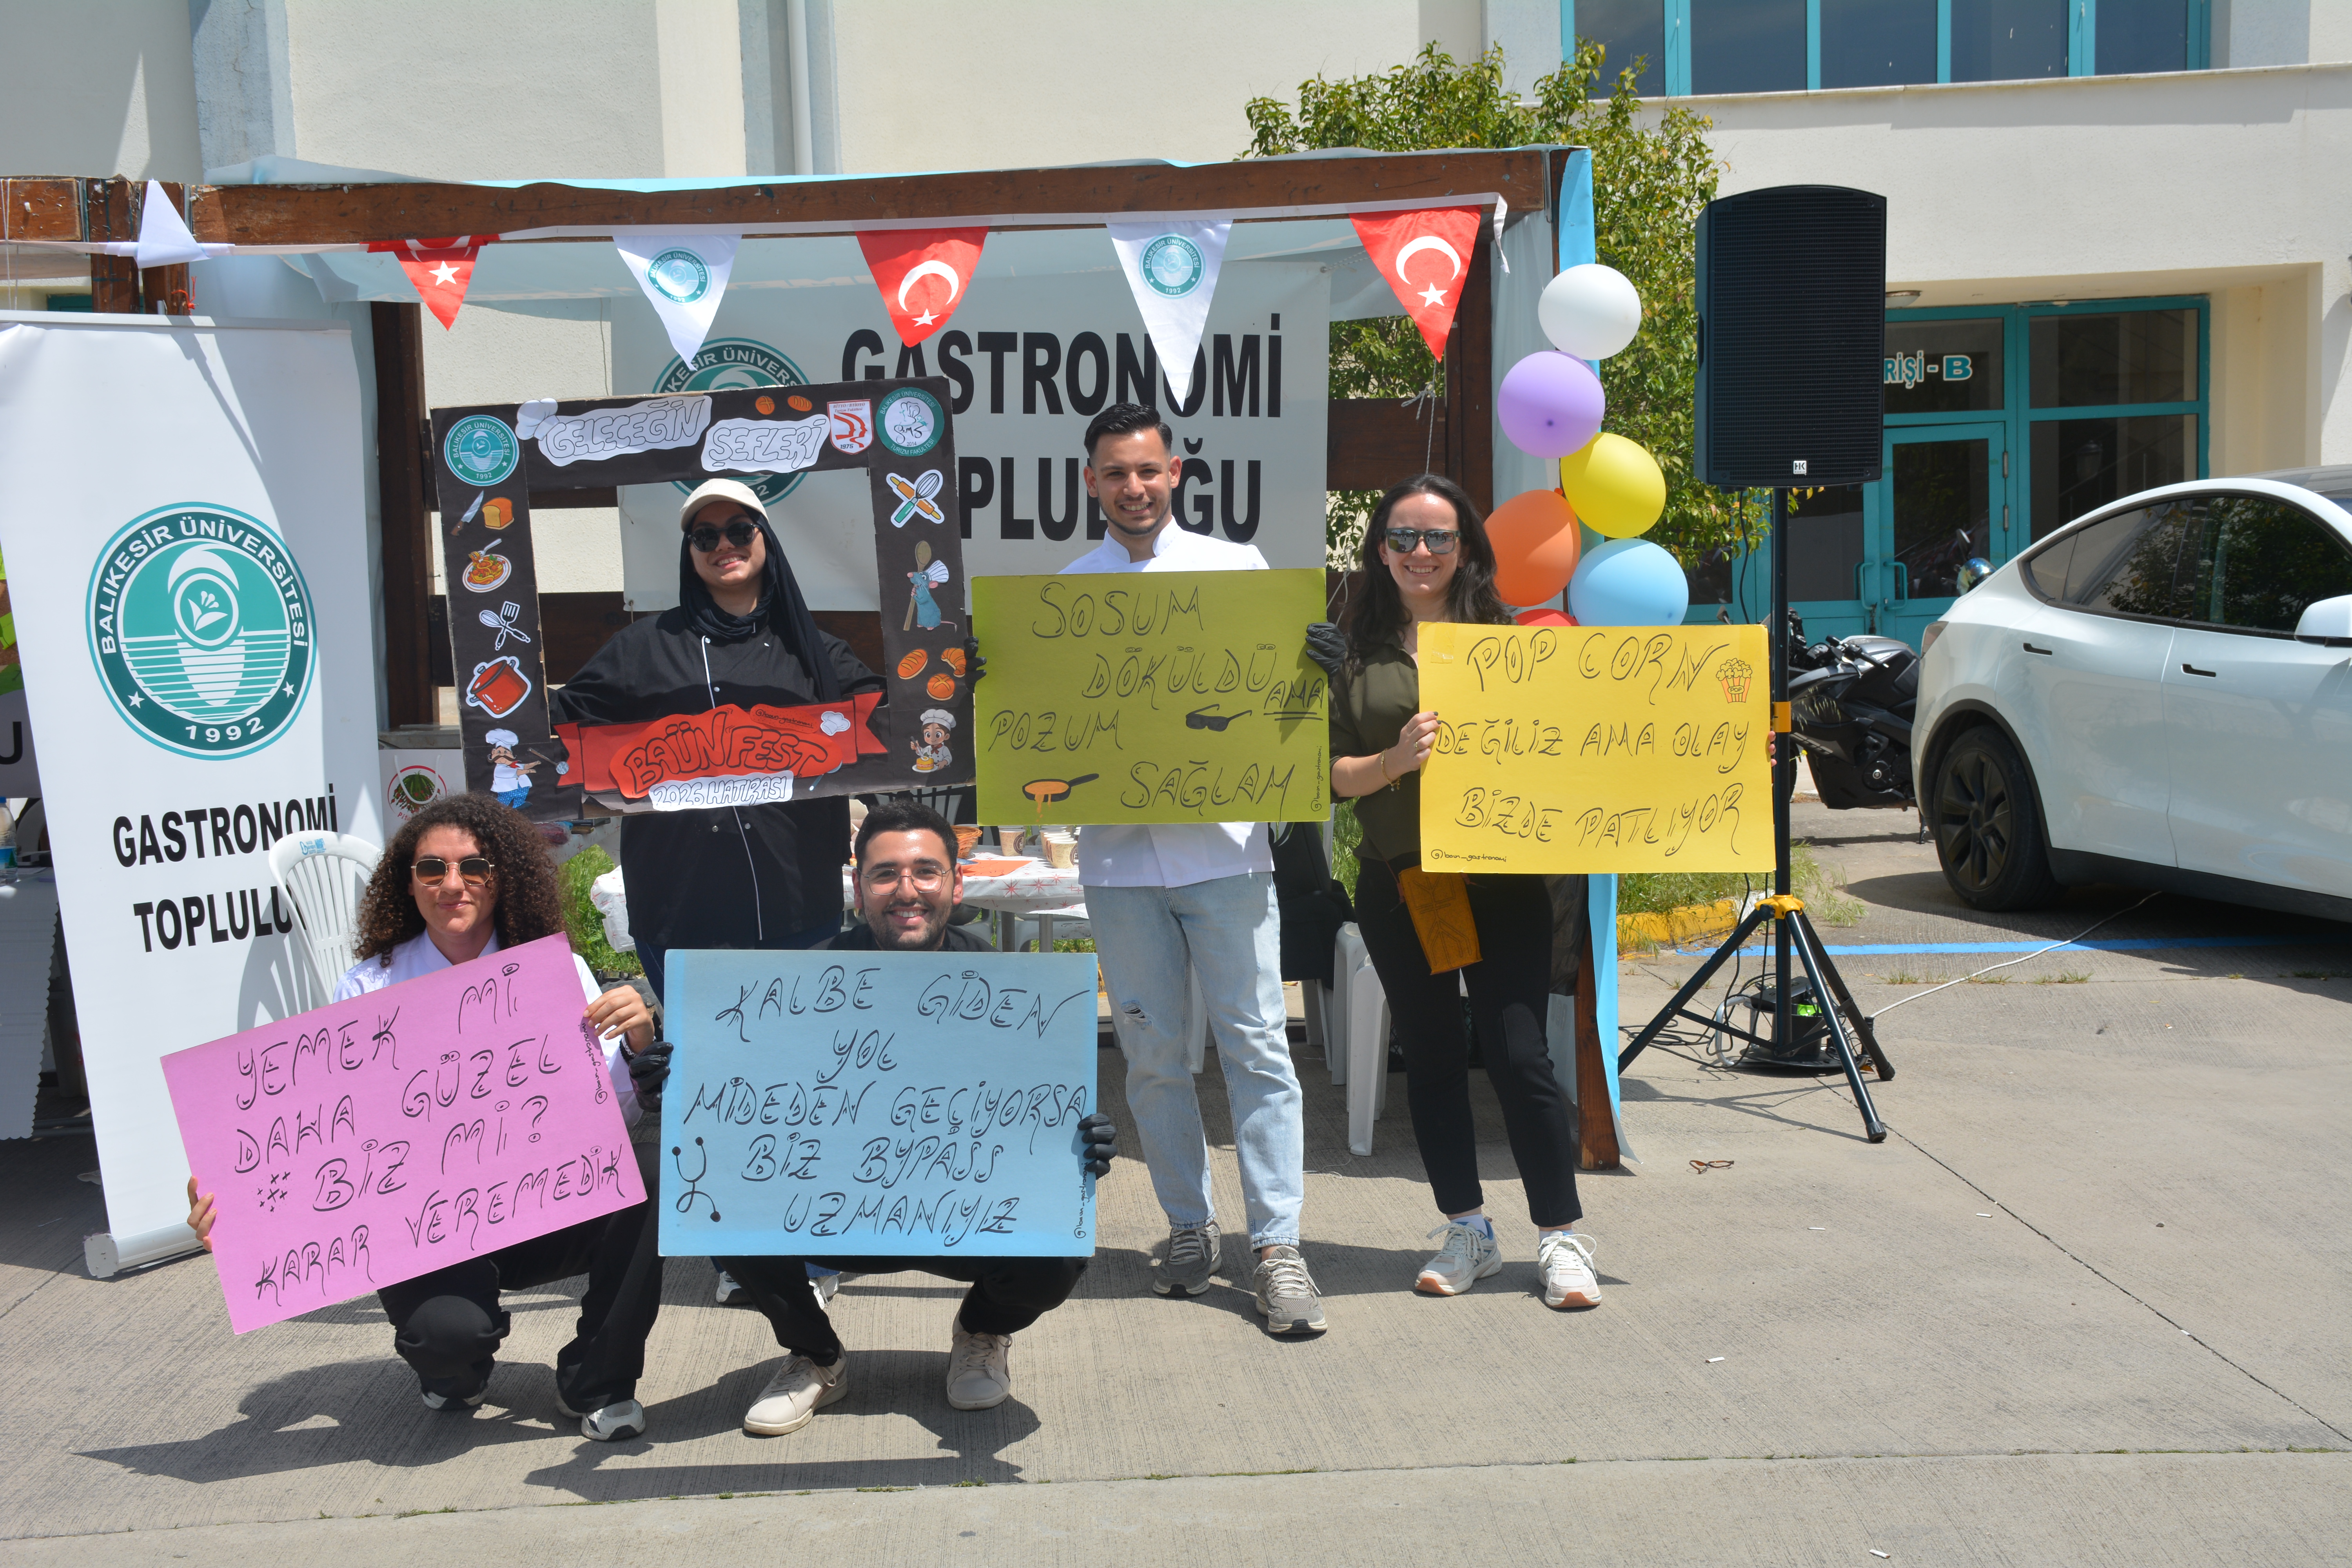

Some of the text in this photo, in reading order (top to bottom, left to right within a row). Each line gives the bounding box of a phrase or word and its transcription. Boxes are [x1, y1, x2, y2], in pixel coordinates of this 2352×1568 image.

[650, 252, 706, 282] BALIKESİR ÜNİVERSİTESİ
[1145, 238, 1200, 269] BALIKESİR ÜNİVERSİTESİ
[880, 390, 935, 414] BALIKESİR ÜNİVERSİTESİ
[453, 421, 511, 458] BALIKESİR ÜNİVERSİTESİ
[709, 419, 826, 469] ŞEFLERİ
[891, 438, 934, 455] TURİZM FAKÜLTESİ
[99, 516, 308, 654] BALIKESİR ÜNİVERSİTESİ
[1032, 582, 1204, 639] SOSUM
[1082, 643, 1324, 710] DÖKÜLDÜ AMA
[1466, 628, 1730, 705] POP CORN
[185, 717, 264, 742] 1992
[988, 709, 1123, 752] POZUM
[1436, 719, 1749, 774] DEĞİLİZ AMA OLAY
[654, 777, 787, 807] 2026 HATIRASI
[1121, 760, 1295, 822] SAĞLAM
[1455, 782, 1744, 857] BİZDE PATLIYOR
[113, 783, 338, 867] GASTRONOMİ
[133, 885, 307, 953] TOPLULU
[715, 965, 1090, 1042] KALBE GİDEN
[236, 963, 521, 1110] YEMEK Mİ
[817, 1029, 898, 1083] YOL
[235, 1034, 561, 1173] DAHA GÜZEL
[684, 1076, 1087, 1155] MİDEDEN GEÇİYORSA
[313, 1095, 549, 1212] BİZ Mİ?
[741, 1132, 1004, 1189] BİZ BYPASS
[255, 1143, 626, 1307] KARAR VEREMEDİK
[784, 1189, 1020, 1247] UZMANIYIZ
